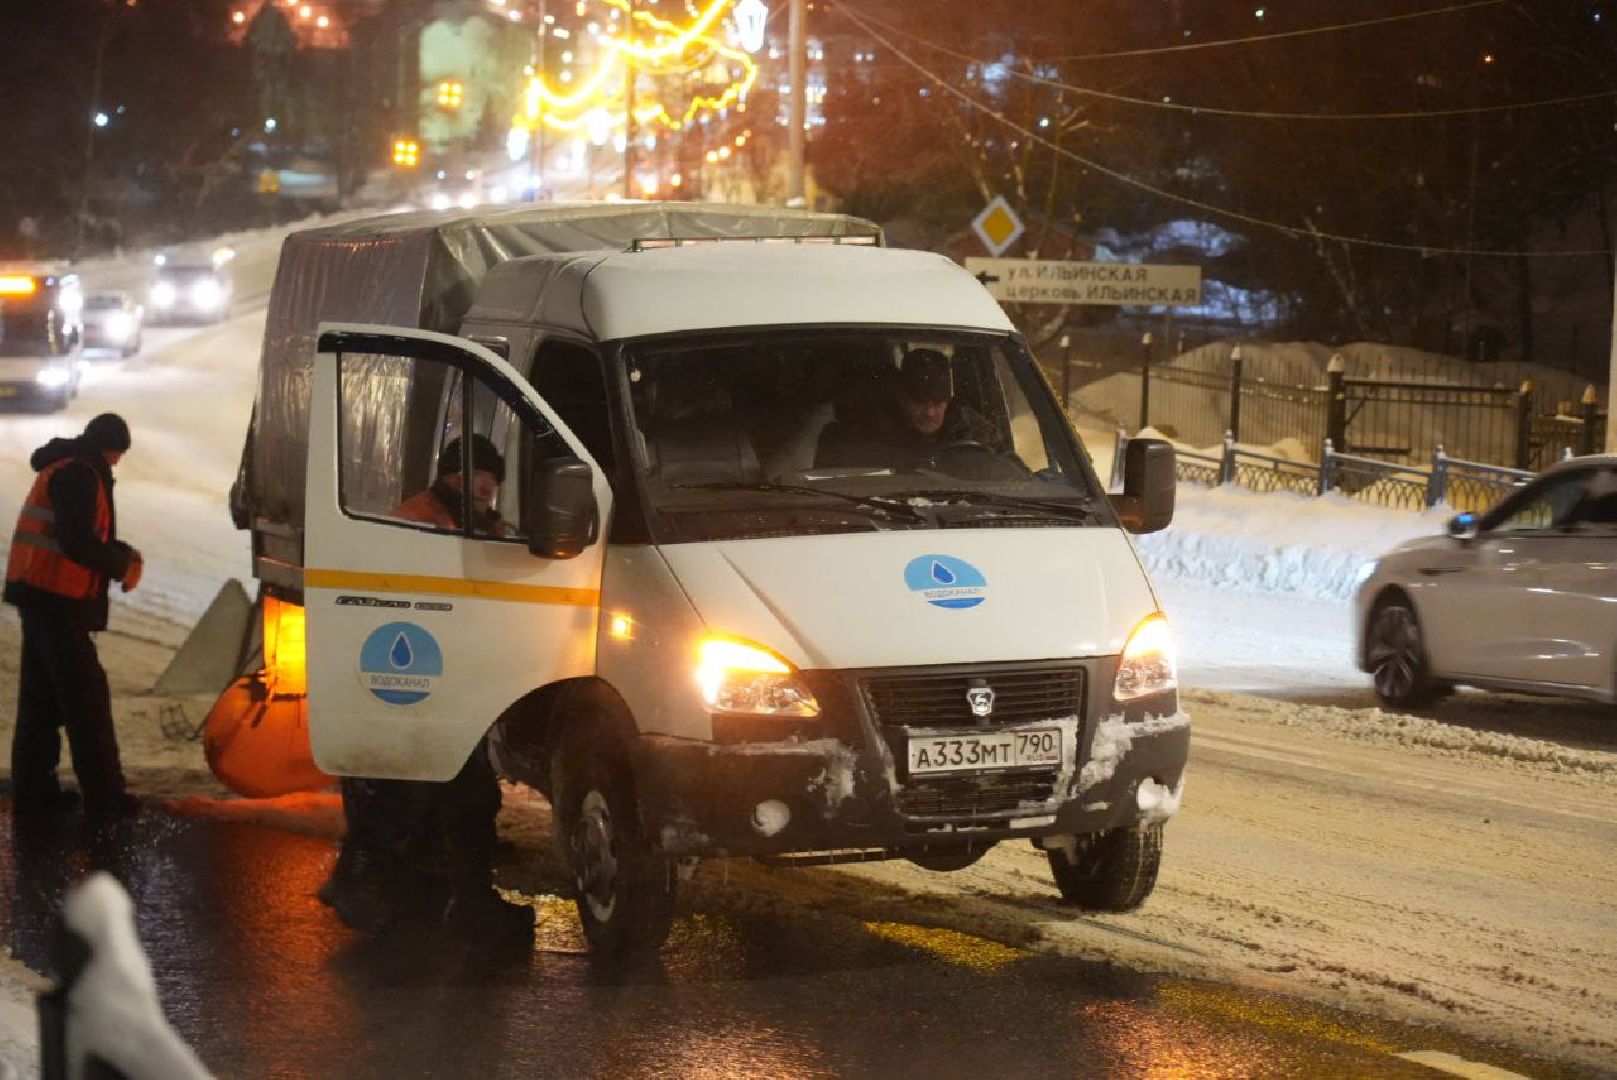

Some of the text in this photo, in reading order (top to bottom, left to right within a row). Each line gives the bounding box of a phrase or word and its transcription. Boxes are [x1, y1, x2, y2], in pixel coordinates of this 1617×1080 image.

[1007, 265, 1149, 282] ул. ИЛЬИНСКАЯ
[1005, 285, 1198, 301] церковь ИЛЬИНСКАЯ
[370, 674, 431, 689] ВОДОКАНАЛ
[1017, 734, 1053, 755] 790
